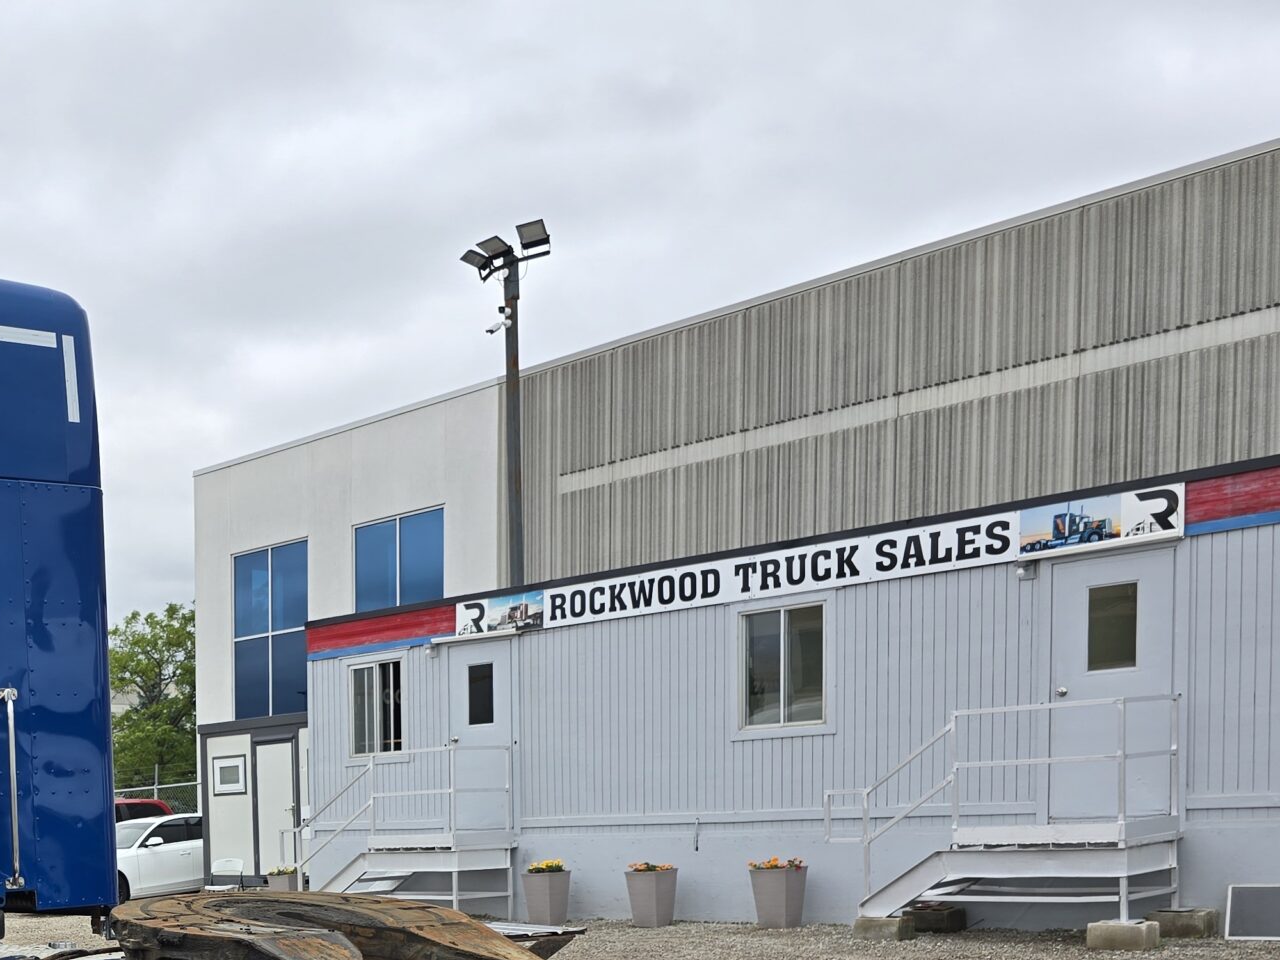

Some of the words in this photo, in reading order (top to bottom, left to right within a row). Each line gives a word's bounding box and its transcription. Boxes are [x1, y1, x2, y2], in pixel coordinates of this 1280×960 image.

[549, 570, 722, 621] ROCKWOOD
[734, 545, 860, 594] TRUCK
[875, 520, 1011, 572] SALES
